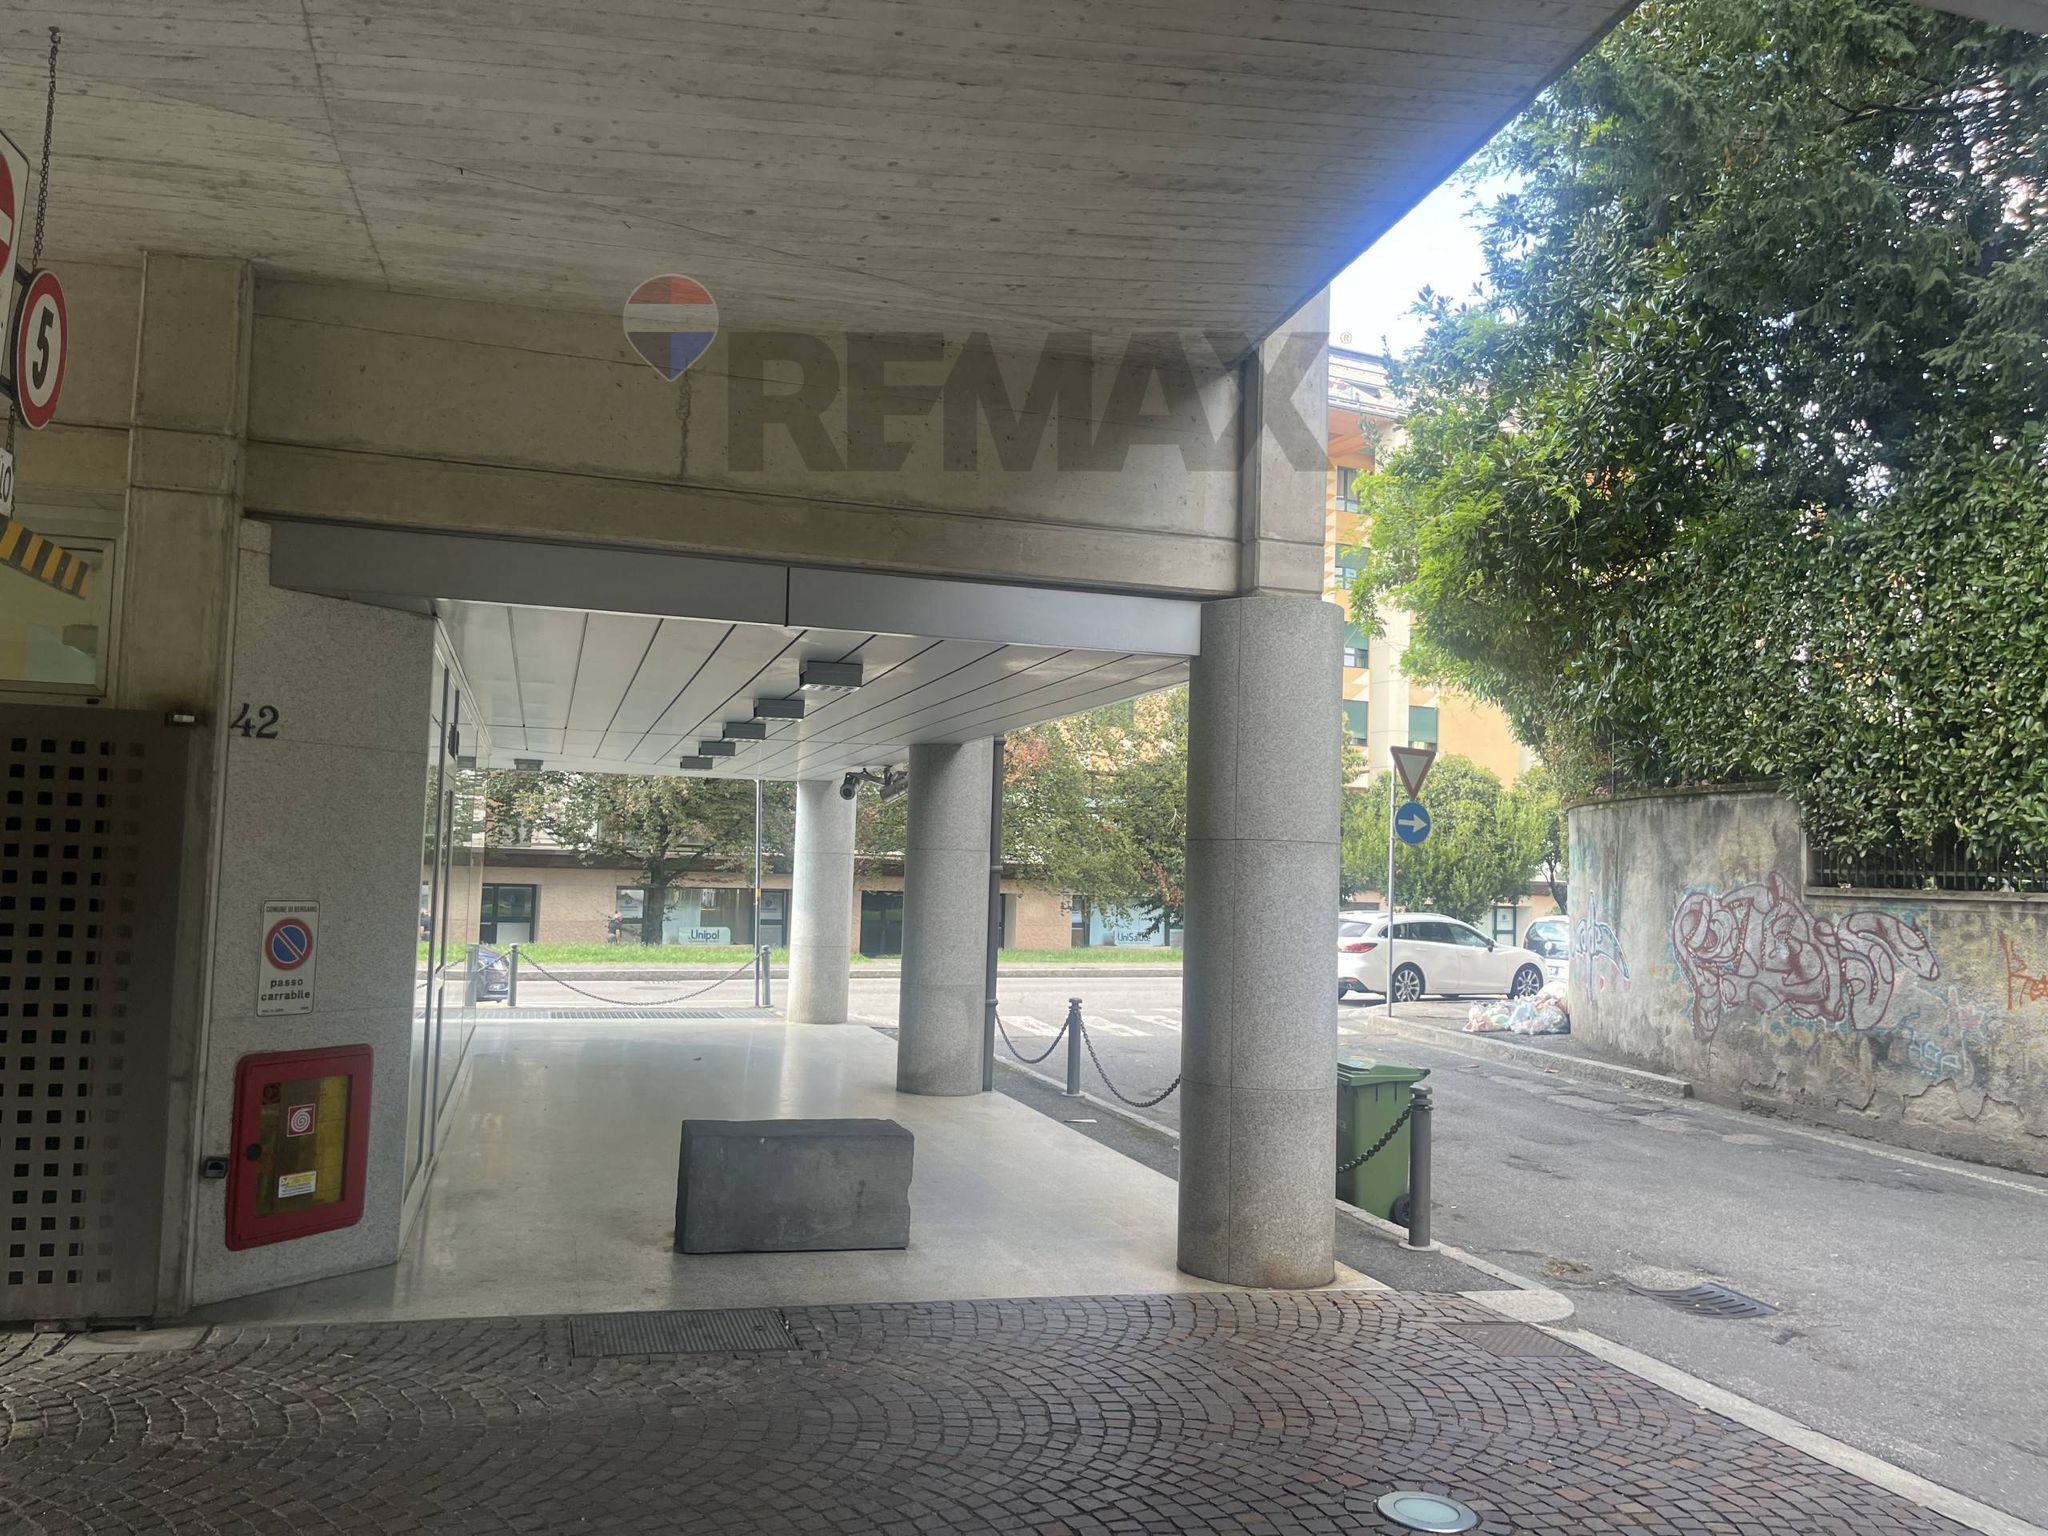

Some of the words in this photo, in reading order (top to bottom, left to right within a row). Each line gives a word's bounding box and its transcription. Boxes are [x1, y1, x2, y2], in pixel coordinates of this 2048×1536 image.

[32, 305, 54, 389] 5
[230, 702, 279, 739] 42
[690, 928, 720, 942] Unipol
[270, 978, 304, 989] passo
[261, 989, 311, 1001] carrabile
